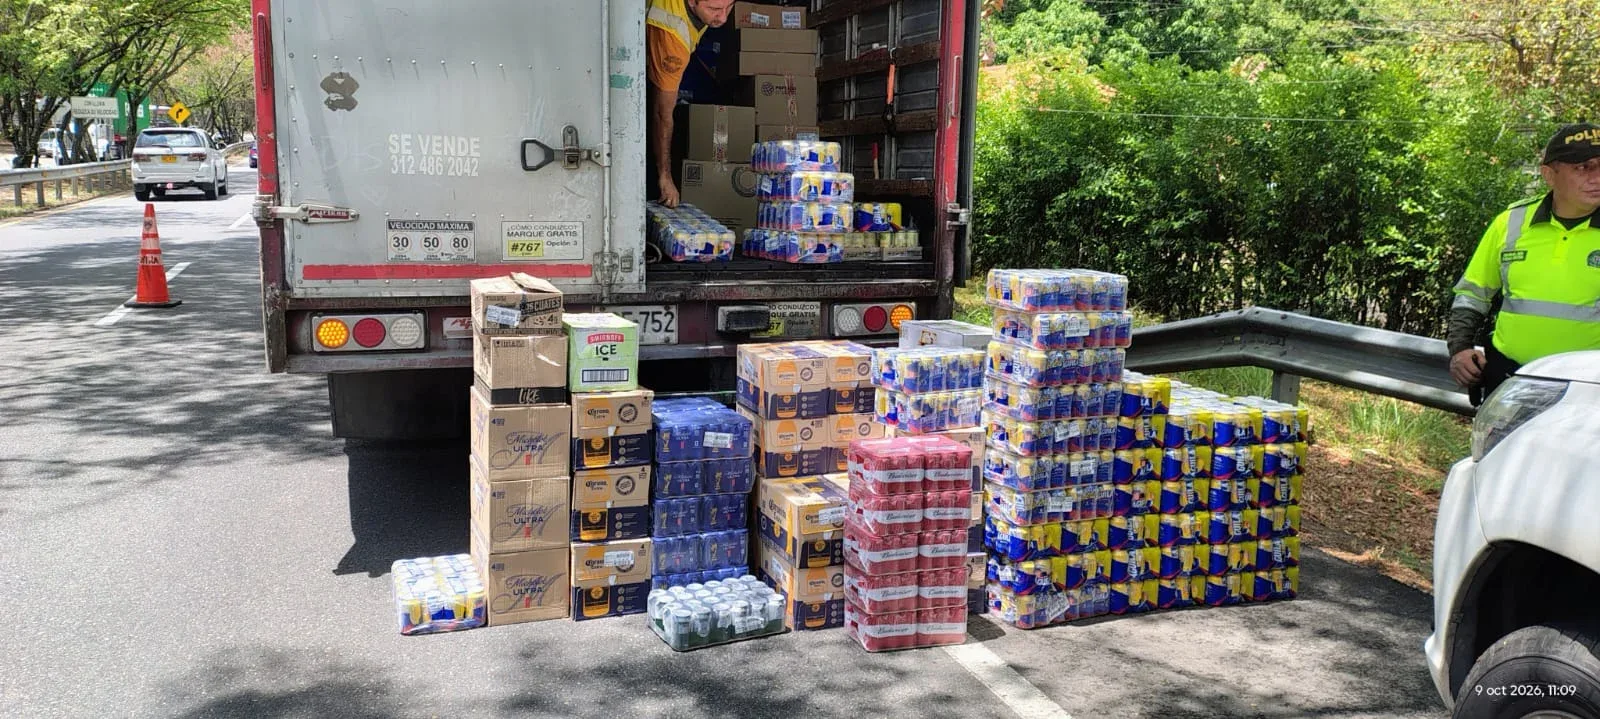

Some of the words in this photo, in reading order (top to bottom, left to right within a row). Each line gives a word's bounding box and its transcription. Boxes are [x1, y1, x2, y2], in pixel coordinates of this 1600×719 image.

[389, 133, 411, 154] SE
[418, 134, 481, 157] VENDE
[391, 156, 415, 175] 312
[419, 156, 443, 176] 486
[447, 156, 479, 177] 2042
[390, 221, 435, 230] VELOCIDAD
[437, 222, 470, 230] MAXIMA
[392, 236, 409, 248] 30
[423, 236, 440, 248] 50
[452, 237, 469, 249] 80
[511, 242, 541, 252] #767
[595, 344, 617, 355] ICE
[513, 516, 544, 525] ULTRA
[512, 587, 543, 596] ULTRA
